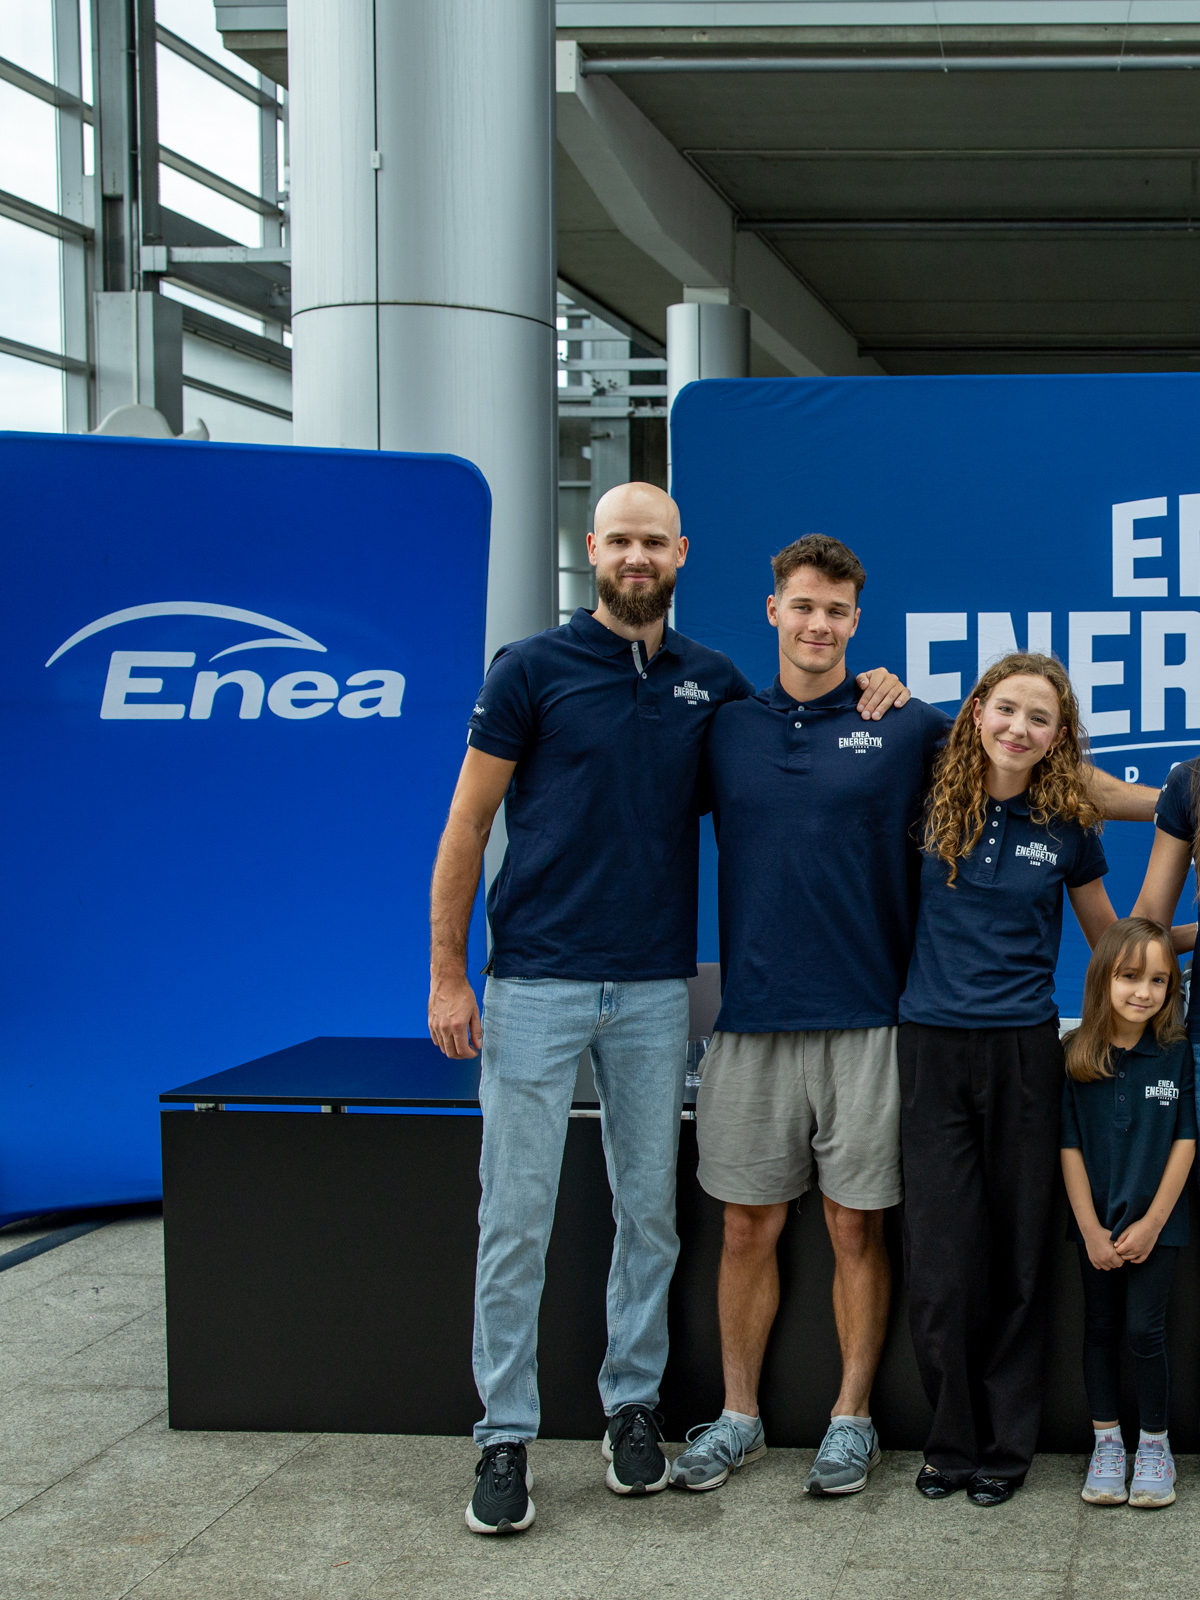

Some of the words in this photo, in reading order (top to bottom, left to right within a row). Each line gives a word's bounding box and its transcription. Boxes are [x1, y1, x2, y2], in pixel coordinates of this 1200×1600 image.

[100, 651, 406, 719] Enea
[684, 681, 699, 689] ENEA
[674, 685, 710, 701] ENERGETYK
[838, 737, 883, 747] ENERGETYK
[1030, 842, 1047, 851] ENEA
[1015, 845, 1058, 864] ENERGETYK
[1158, 1080, 1174, 1088] ENEA
